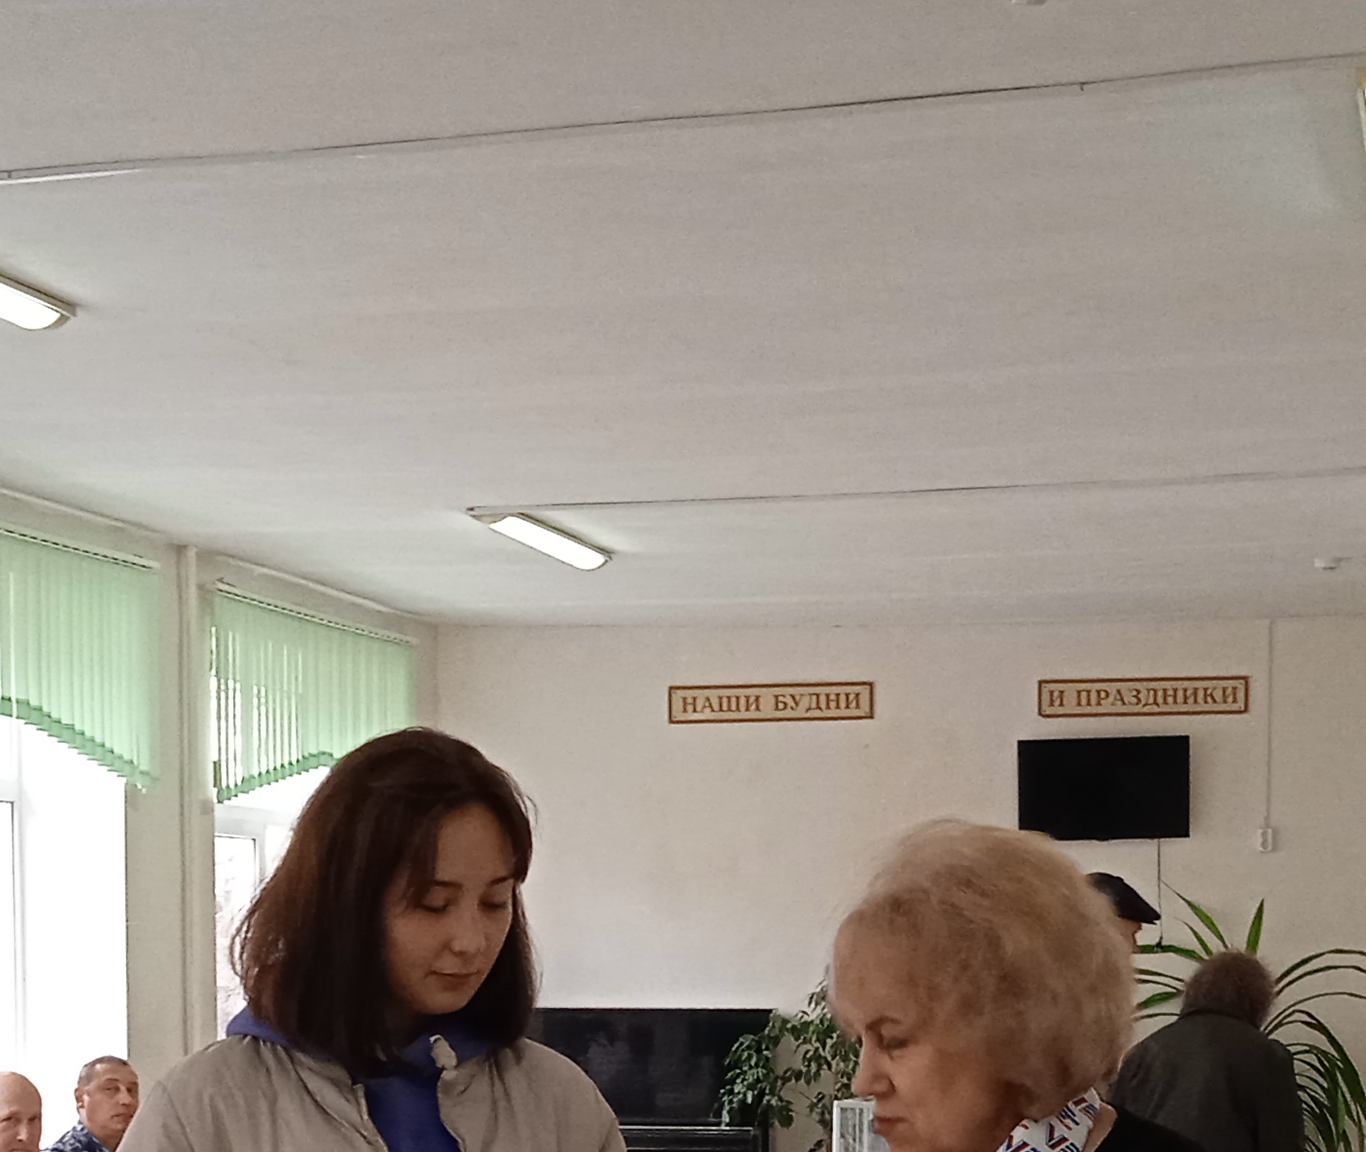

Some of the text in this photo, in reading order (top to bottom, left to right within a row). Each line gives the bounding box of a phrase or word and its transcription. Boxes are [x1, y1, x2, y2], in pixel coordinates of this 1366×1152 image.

[681, 691, 863, 714] НАШИ БУДНИ
[1048, 685, 1239, 708] И ПРАЗДНИКИ
